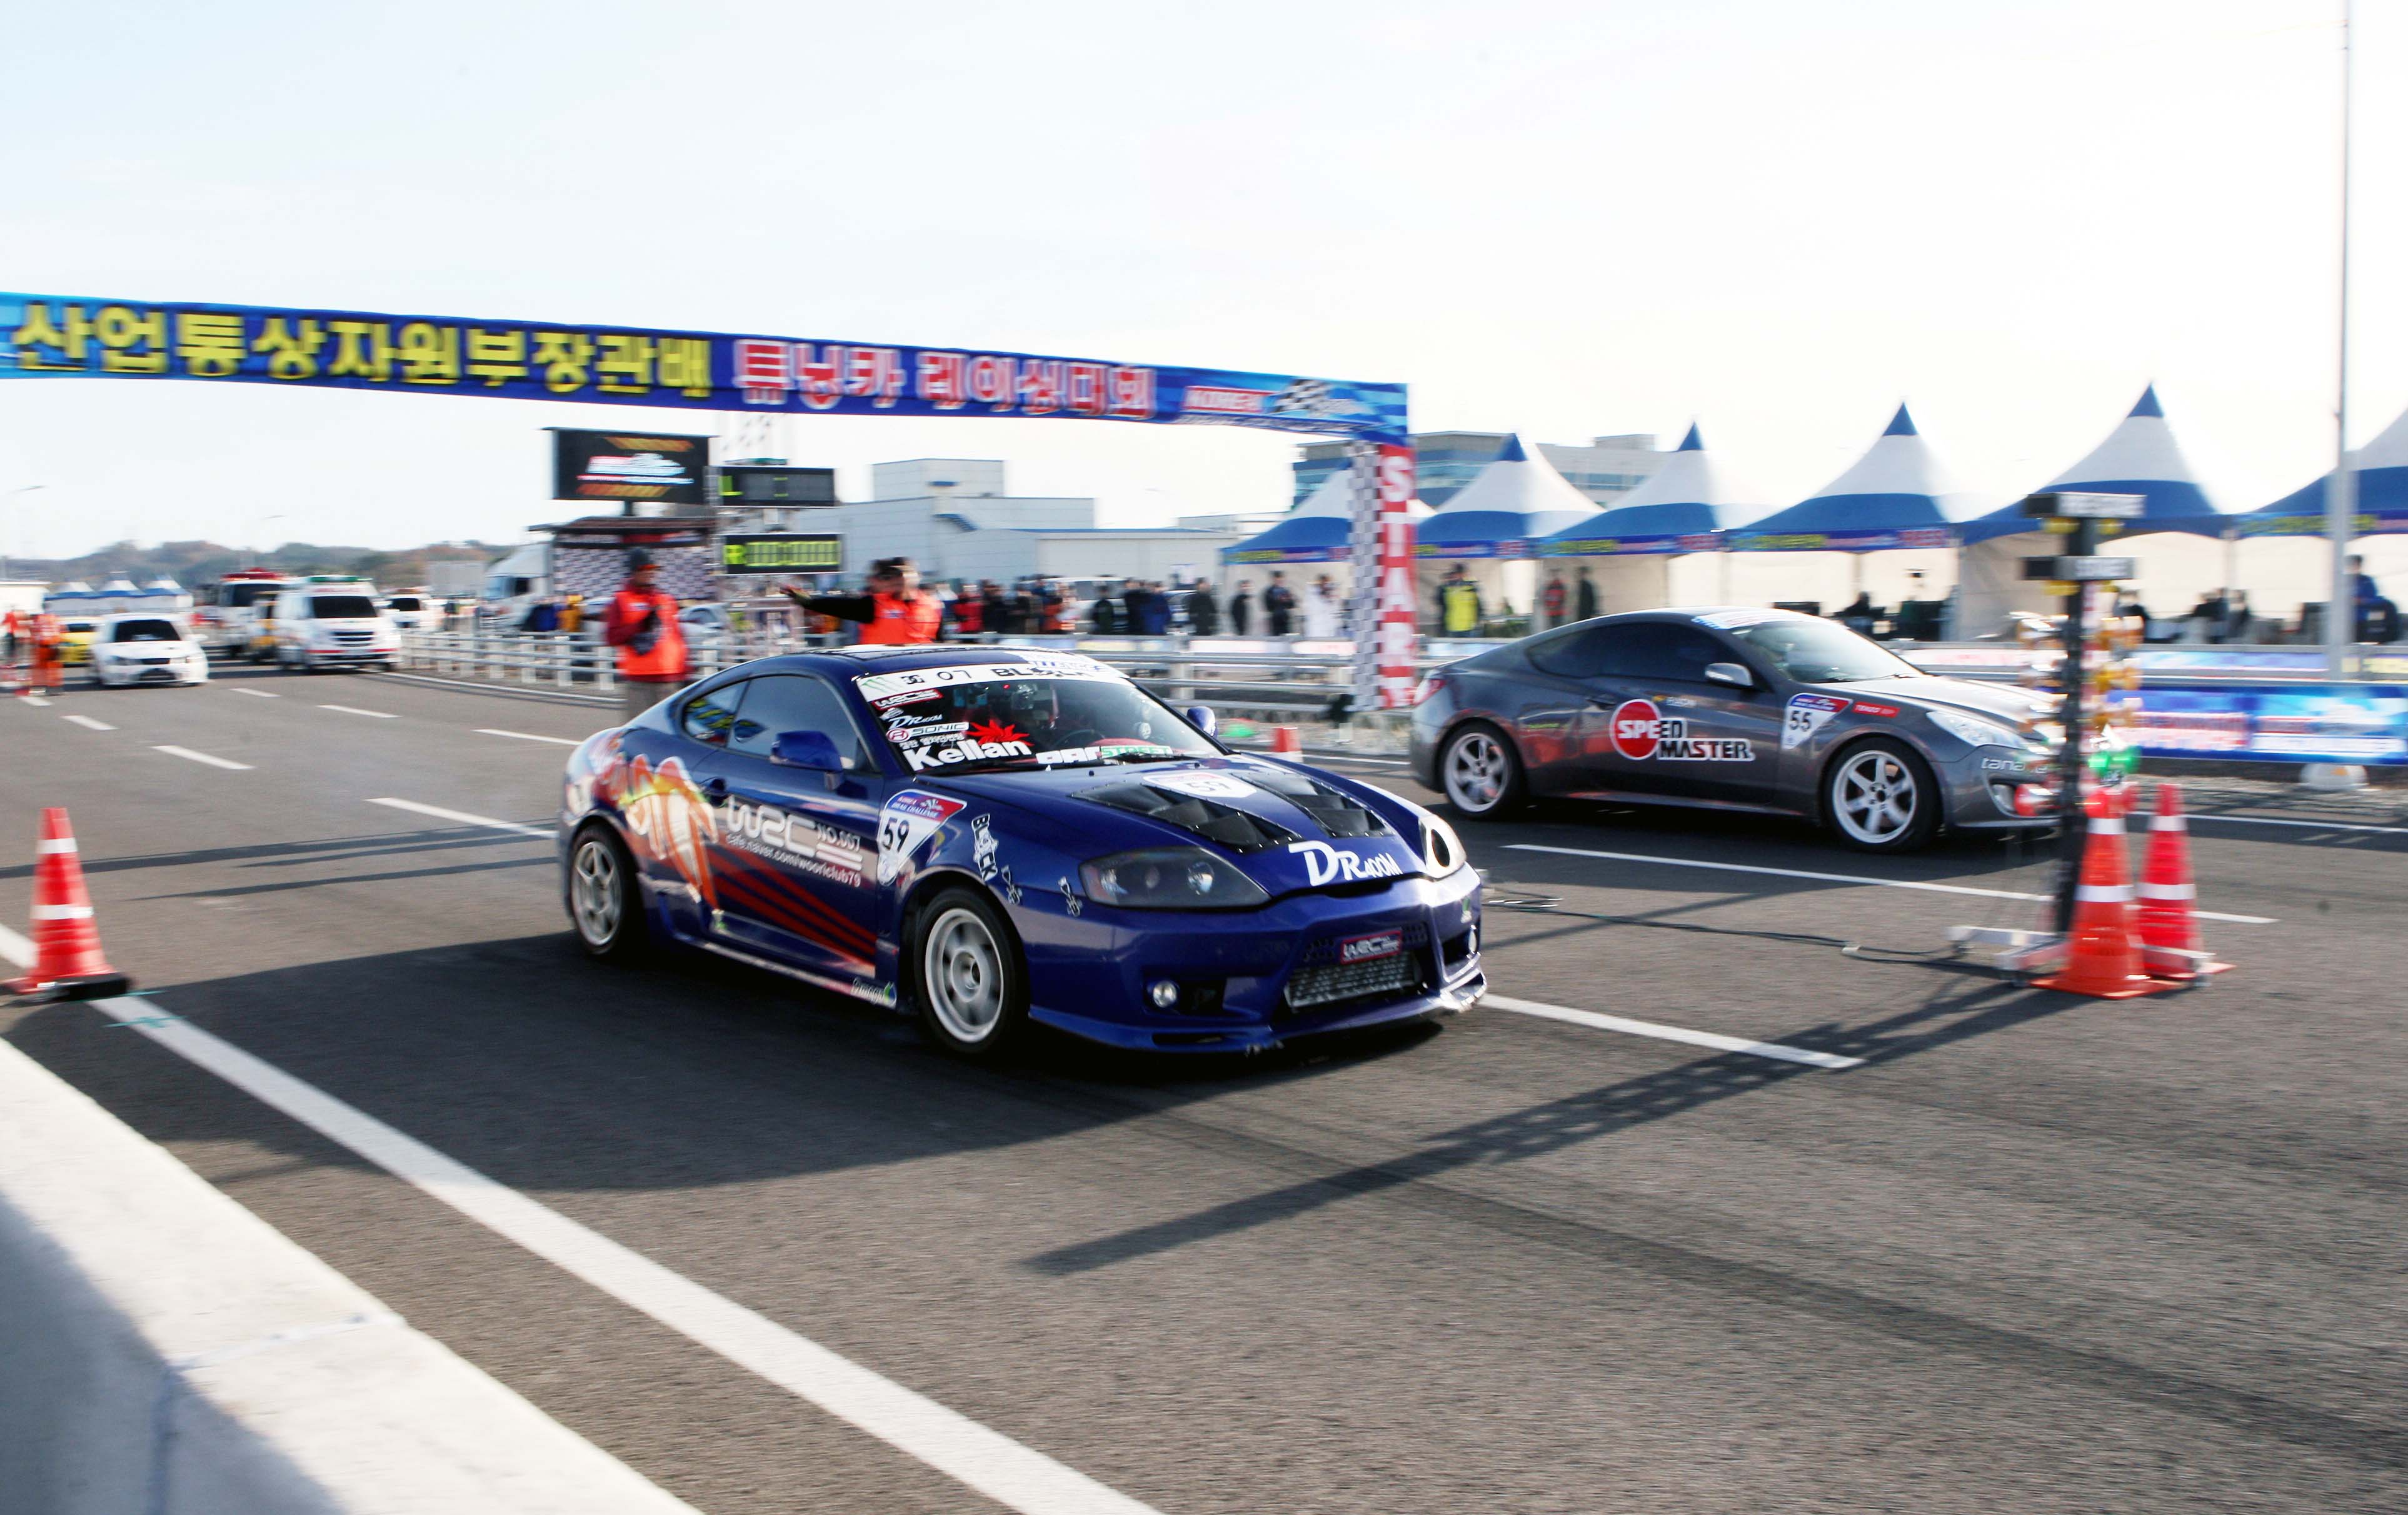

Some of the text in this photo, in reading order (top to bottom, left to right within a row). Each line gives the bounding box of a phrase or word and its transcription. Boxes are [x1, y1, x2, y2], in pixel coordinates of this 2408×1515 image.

[1618, 719, 1683, 739] SPEED
[1789, 710, 1812, 732] 55
[902, 739, 1032, 771] Kellan
[1660, 740, 1750, 759] MASTER
[883, 816, 910, 852] 59
